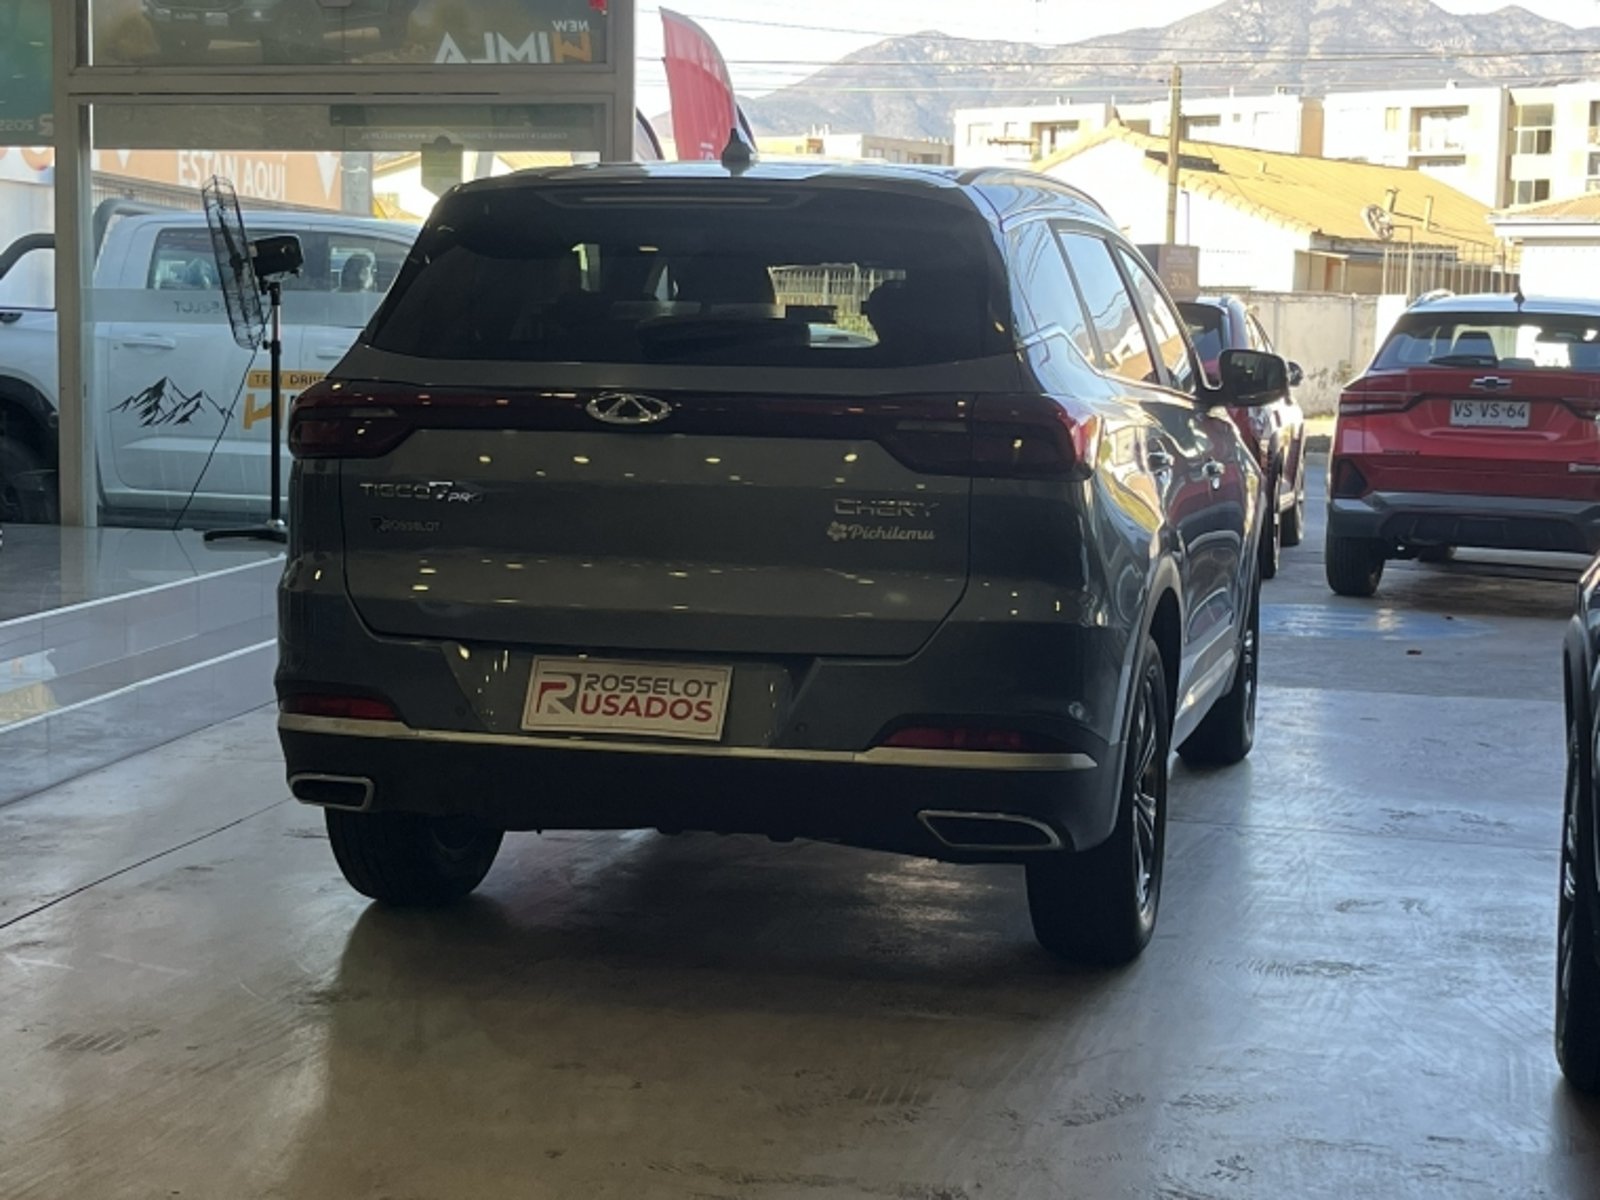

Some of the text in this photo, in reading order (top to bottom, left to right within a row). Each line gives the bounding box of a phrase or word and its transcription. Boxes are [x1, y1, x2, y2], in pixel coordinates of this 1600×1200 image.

[1453, 402, 1473, 418] VS
[1479, 403, 1500, 418] VS
[834, 498, 940, 517] CHERY
[847, 524, 936, 540] Pichilemu
[583, 673, 717, 698] ROSSELOT
[580, 693, 713, 722] USADOS
